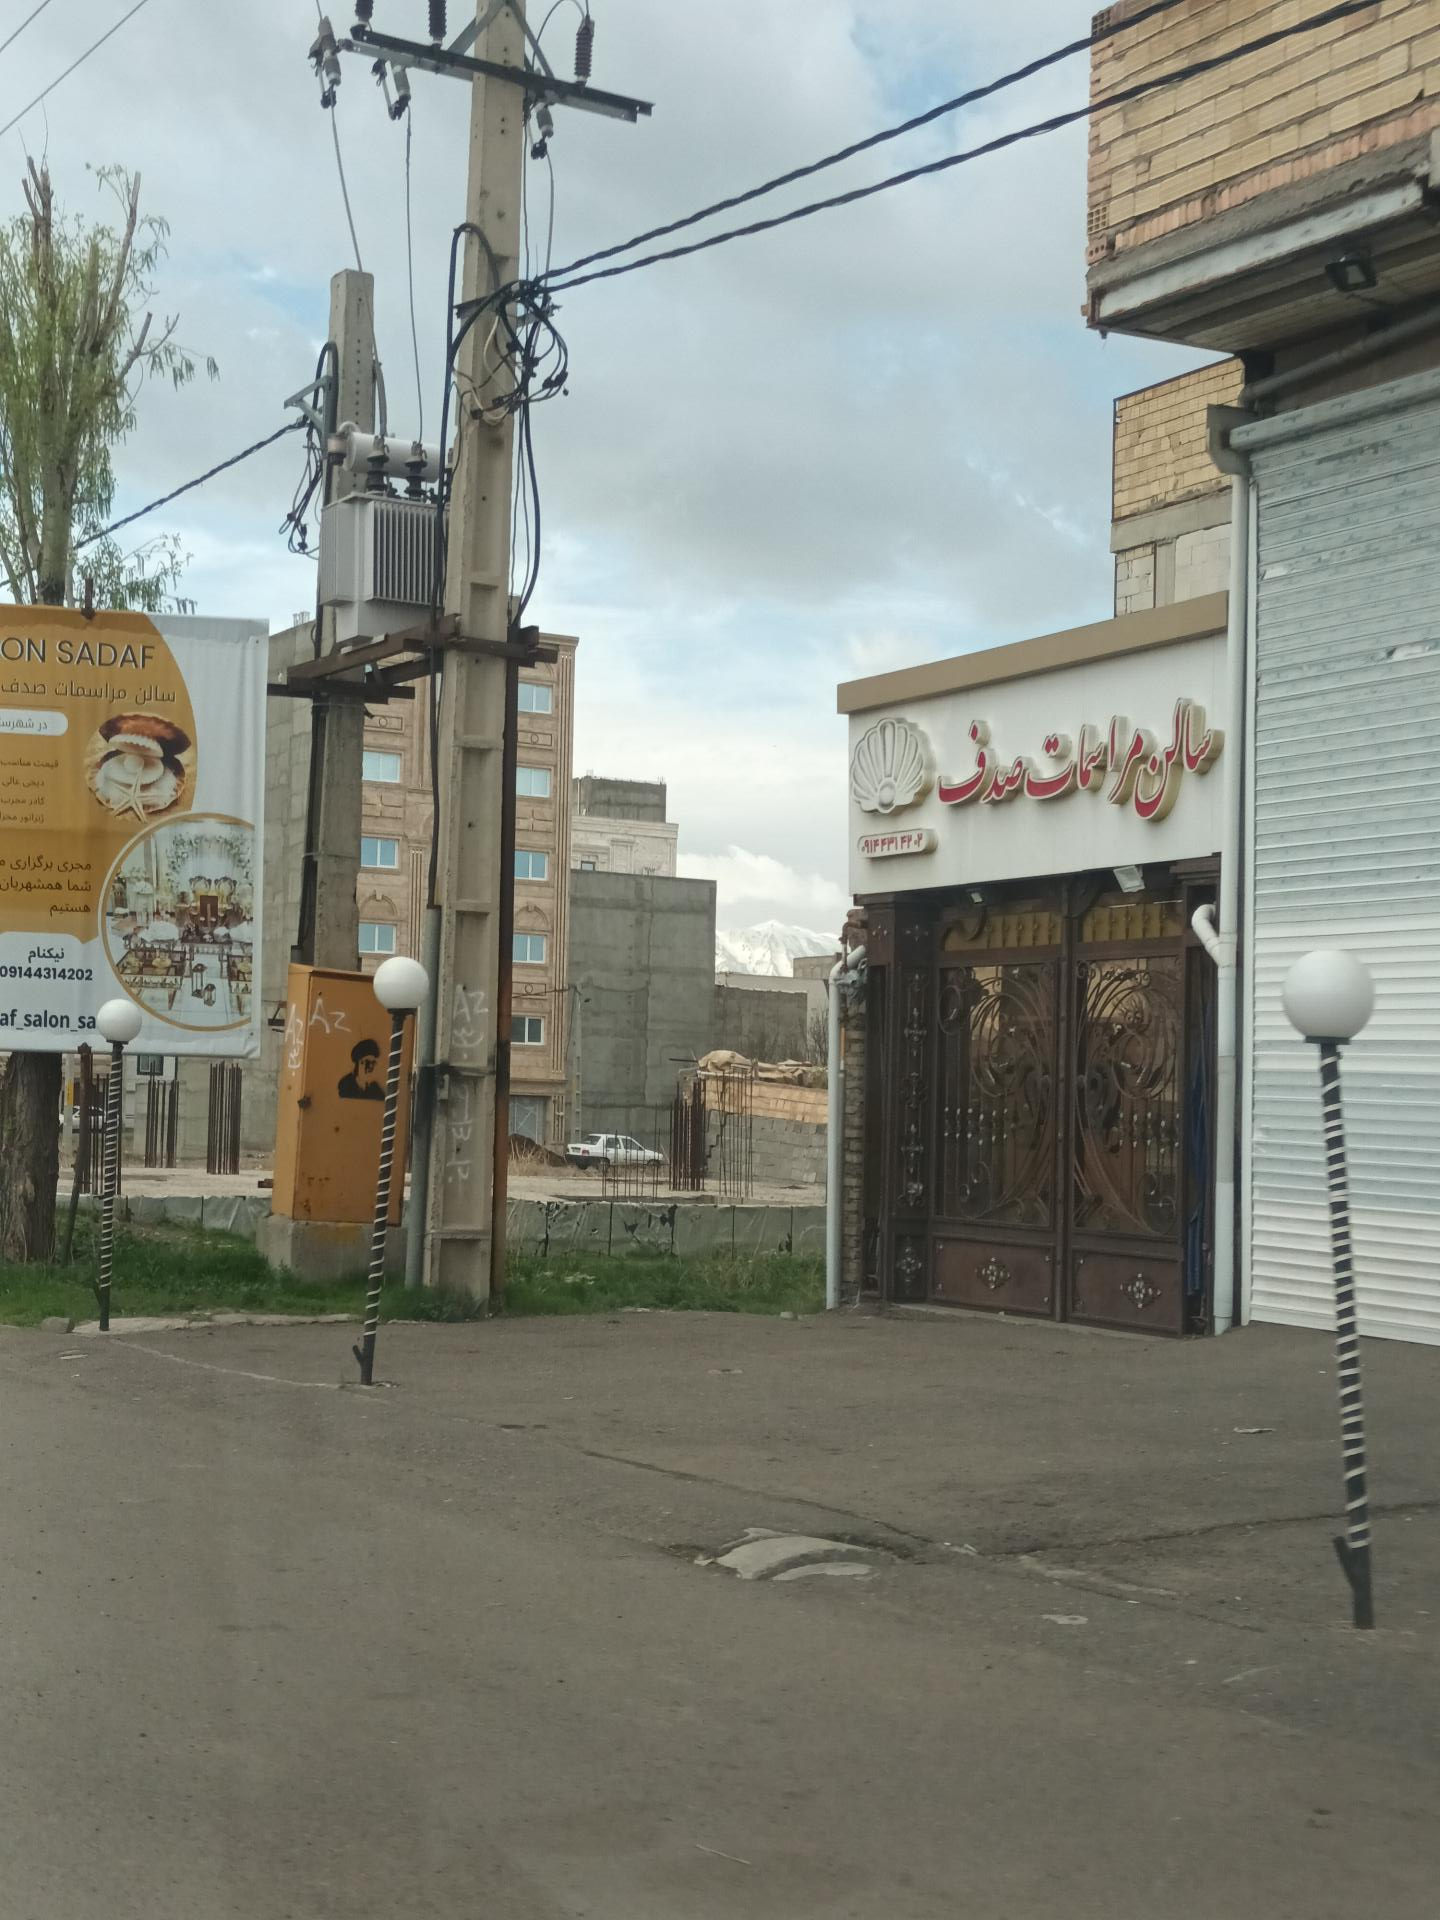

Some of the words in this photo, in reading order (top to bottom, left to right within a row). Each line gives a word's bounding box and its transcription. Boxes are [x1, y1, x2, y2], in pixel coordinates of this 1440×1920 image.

[56, 639, 155, 670] SADAF
[1, 678, 47, 695] صدف
[55, 680, 127, 704] مراسمات
[135, 685, 177, 706] سالن
[937, 719, 1029, 805] صدف
[1024, 715, 1149, 804] مراسمات
[1133, 697, 1221, 821] سالن
[10, 854, 54, 872] برگزاری
[57, 860, 92, 873] مجری
[67, 879, 92, 892] شما
[49, 903, 91, 917] هستیم
[28, 946, 65, 964] نیکنام
[0, 965, 93, 981] 09144314202
